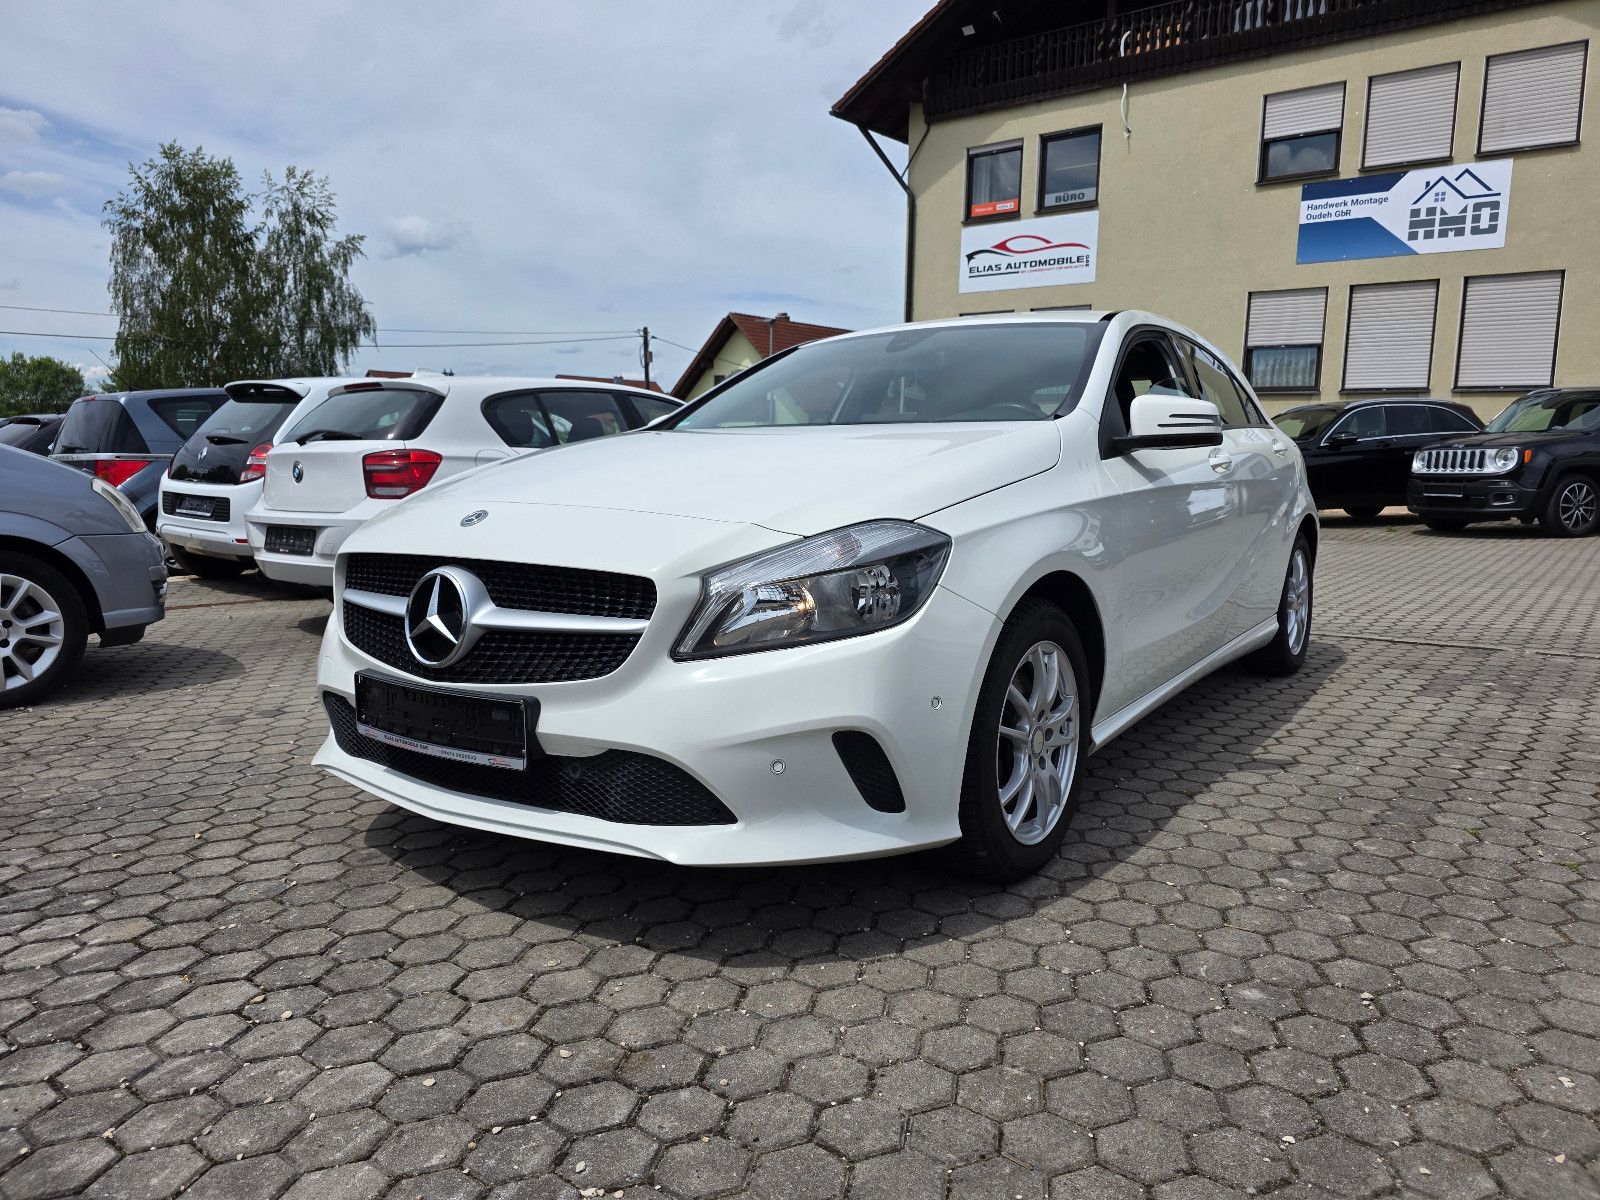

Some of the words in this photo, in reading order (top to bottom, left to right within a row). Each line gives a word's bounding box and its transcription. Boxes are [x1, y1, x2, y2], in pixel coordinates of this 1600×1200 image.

[1055, 192, 1085, 203] BÜRO
[1307, 199, 1348, 211] Handwerk
[1350, 196, 1389, 207] Montage
[1306, 210, 1332, 220] Oudeh
[1334, 209, 1352, 218] GbR
[1407, 200, 1501, 241] HMO
[969, 263, 1002, 274] ELIAS
[1005, 254, 1085, 270] AUTOMOBILE
